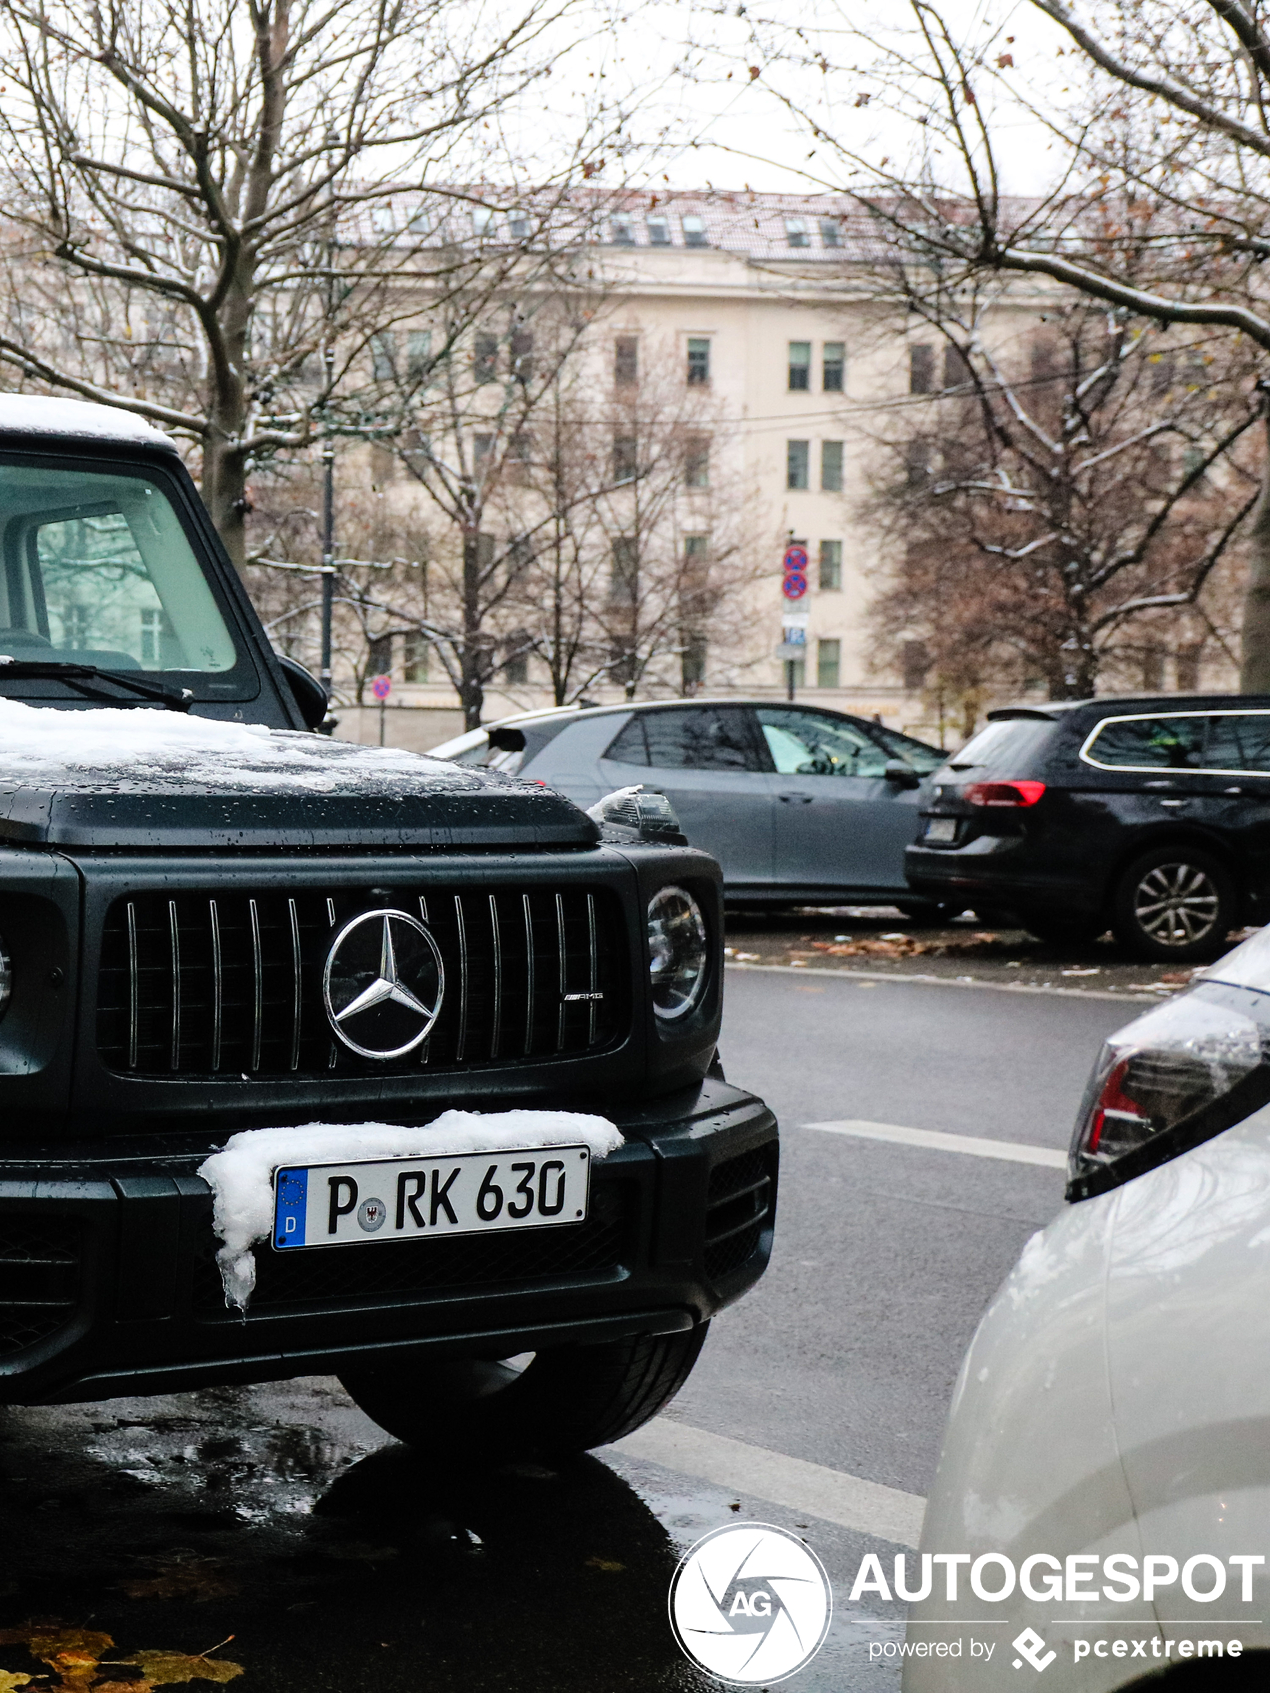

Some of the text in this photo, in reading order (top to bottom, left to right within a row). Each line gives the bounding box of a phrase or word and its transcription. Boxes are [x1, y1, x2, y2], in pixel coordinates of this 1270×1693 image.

[327, 1175, 359, 1235] P
[395, 1167, 462, 1230] RK
[476, 1160, 566, 1222] 630
[285, 1216, 297, 1234] D
